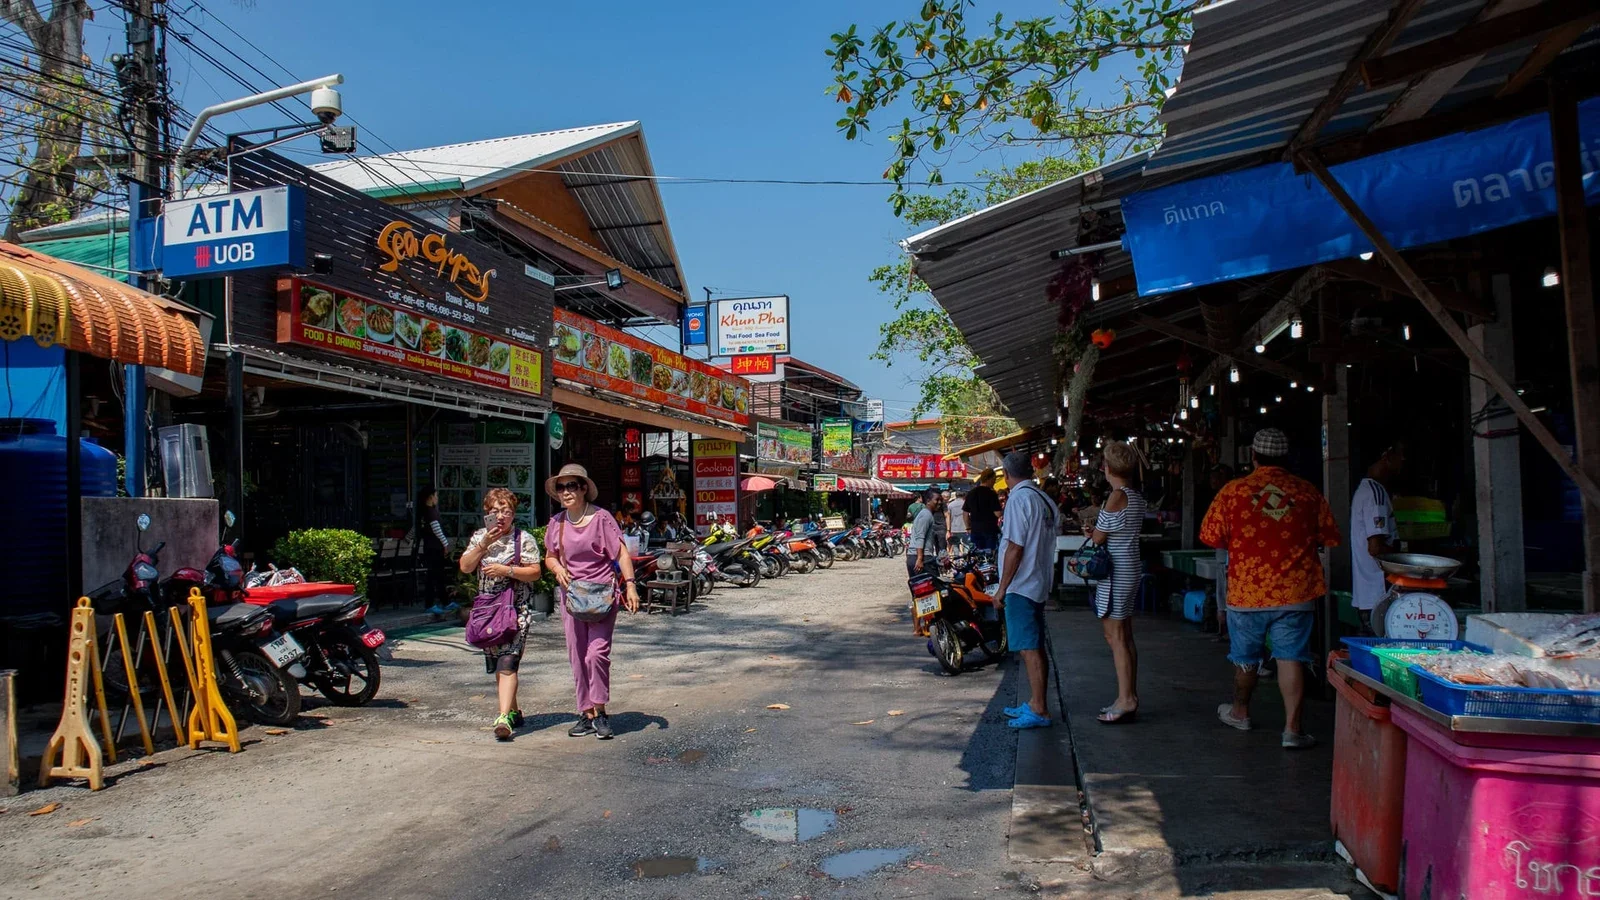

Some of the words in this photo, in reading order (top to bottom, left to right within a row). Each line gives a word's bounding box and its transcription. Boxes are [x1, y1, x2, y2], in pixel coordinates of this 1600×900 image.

[187, 195, 263, 237] ATM
[1163, 199, 1225, 226] ดีแทค
[214, 242, 255, 264] UOB
[377, 220, 418, 272] Sea
[464, 299, 475, 311] Sea
[476, 303, 490, 316] food
[720, 313, 755, 327] Khun
[758, 311, 785, 325] Pha
[303, 328, 325, 342] FOOD
[327, 333, 333, 344] &
[335, 336, 362, 351] DRINKS
[406, 353, 425, 367] Cooking
[656, 348, 674, 365] Khun
[675, 354, 687, 371] Pha
[696, 461, 734, 475] Cooking
[697, 491, 716, 502] 100
[278, 648, 299, 664] 5937
